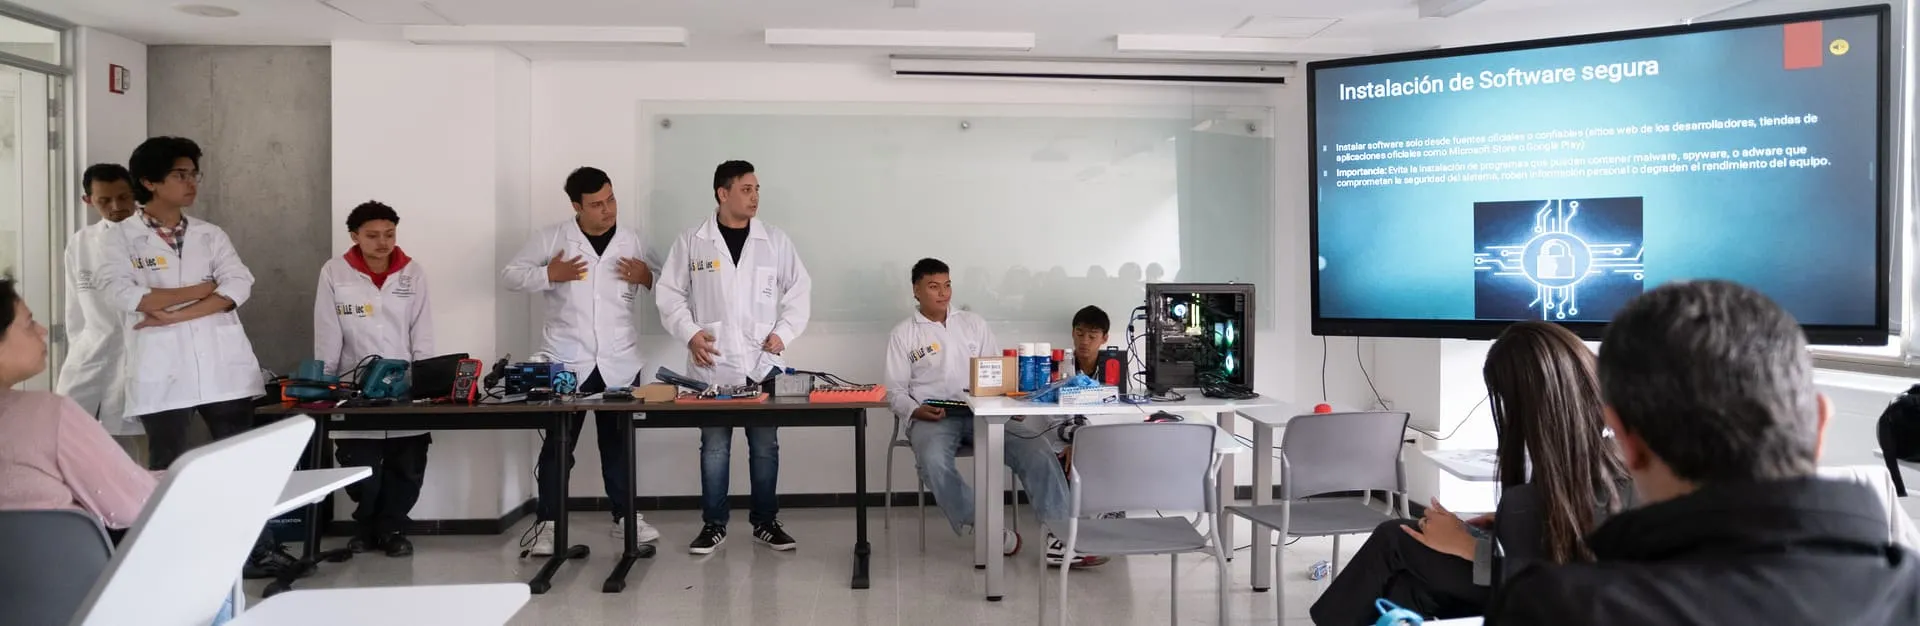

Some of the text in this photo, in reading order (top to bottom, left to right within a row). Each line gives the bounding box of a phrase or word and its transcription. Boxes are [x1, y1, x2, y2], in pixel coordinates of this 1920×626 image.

[1340, 60, 1659, 100] Instalación de Software segura
[1336, 142, 1366, 151] Instalar
[1368, 141, 1404, 150] software
[1406, 138, 1423, 147] solo
[1425, 137, 1450, 146] desde
[1453, 135, 1486, 145] fuentes
[1488, 133, 1525, 142] oficiales
[1617, 125, 1638, 134] web
[1641, 124, 1652, 133] de
[1656, 123, 1669, 132] los
[1672, 119, 1757, 131] desarrolladores,
[1759, 115, 1800, 126] tiendas
[1803, 114, 1818, 123] de
[1336, 152, 1386, 163] aplicaciones
[1387, 150, 1420, 159] oficiales
[1449, 145, 1492, 156] Microsoft
[1493, 144, 1517, 153] Store
[1526, 141, 1558, 152] Google
[1561, 139, 1585, 150] Play)
[1336, 167, 1387, 178] Importancia:
[1389, 166, 1408, 174] Evita
[1420, 162, 1465, 172] instalación
[1530, 159, 1547, 168] que
[1551, 158, 1585, 168] pueden
[1587, 155, 1631, 164] contener
[1634, 153, 1680, 162] malware,
[1683, 150, 1730, 161] spyware,
[1742, 147, 1783, 158] adware
[1785, 146, 1807, 157] que
[1404, 174, 1444, 185] seguridad
[1448, 173, 1460, 182] del
[1501, 170, 1527, 180] roben
[1530, 168, 1585, 178] información
[1587, 166, 1630, 177] personal
[1641, 163, 1688, 174] degraden
[1691, 162, 1700, 171] el
[1702, 160, 1767, 171] rendimiento
[1769, 158, 1787, 168] del
[1789, 156, 1831, 168] equipo.
